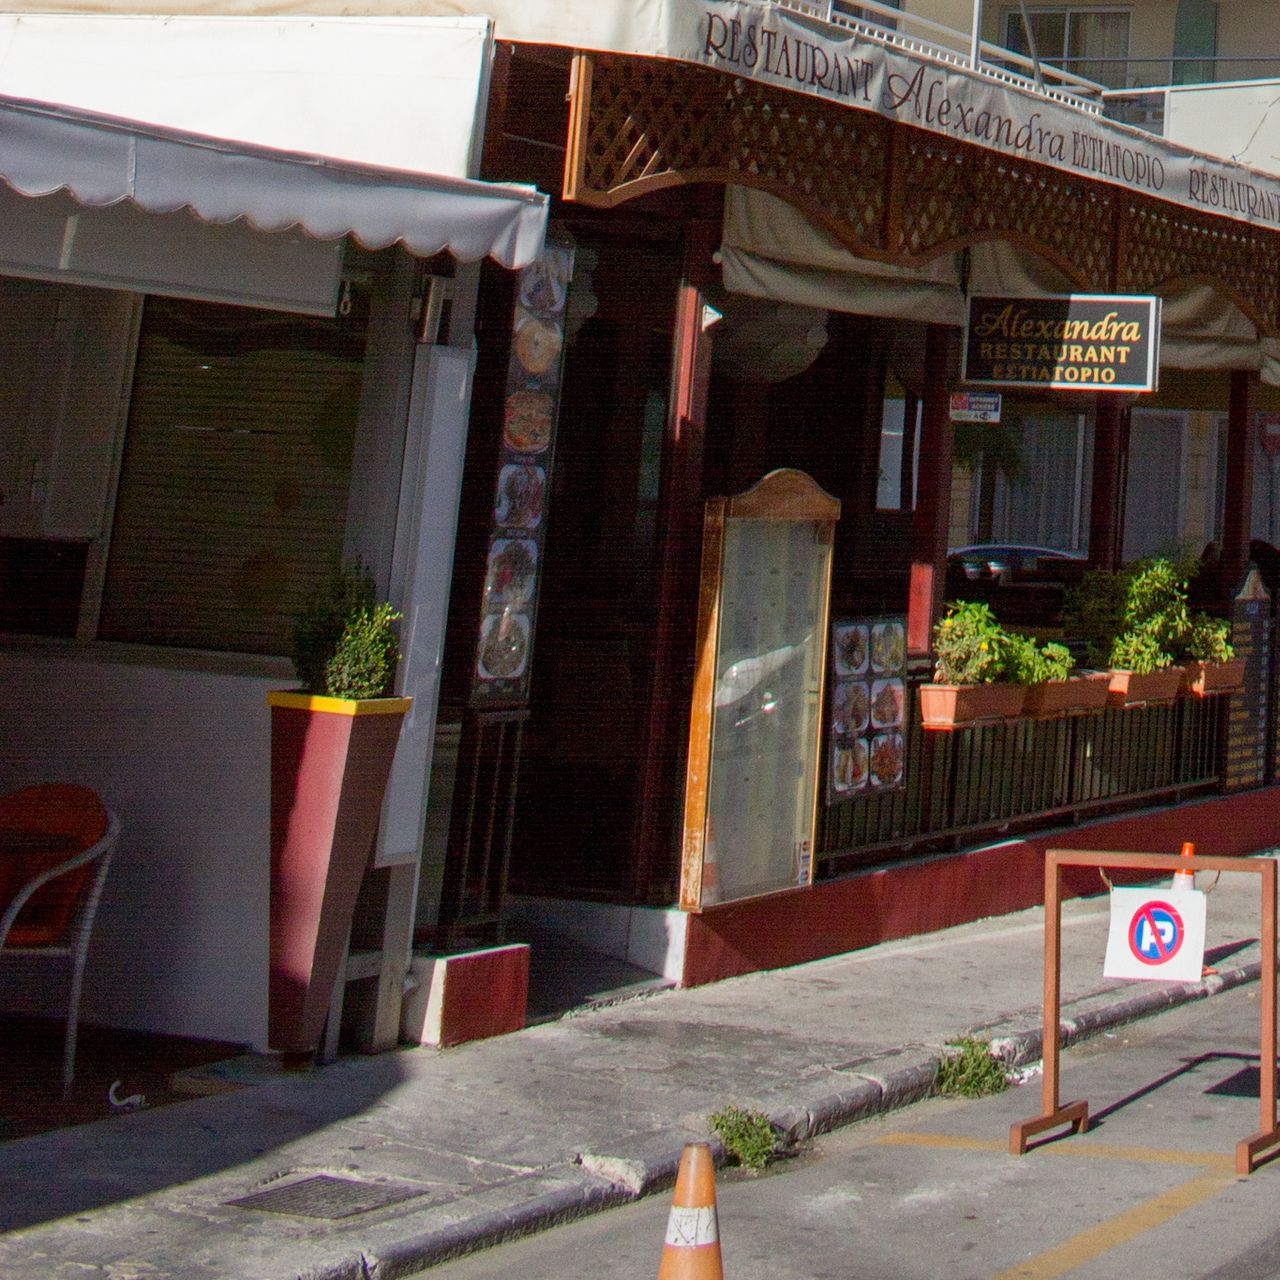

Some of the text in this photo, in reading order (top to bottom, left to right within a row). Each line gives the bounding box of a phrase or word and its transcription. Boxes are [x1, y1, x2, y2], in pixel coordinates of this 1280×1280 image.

[703, 11, 1066, 162] RESTAURANT Alexandra
[973, 303, 1142, 342] Alexandra
[979, 342, 1131, 364] RESTAURANT
